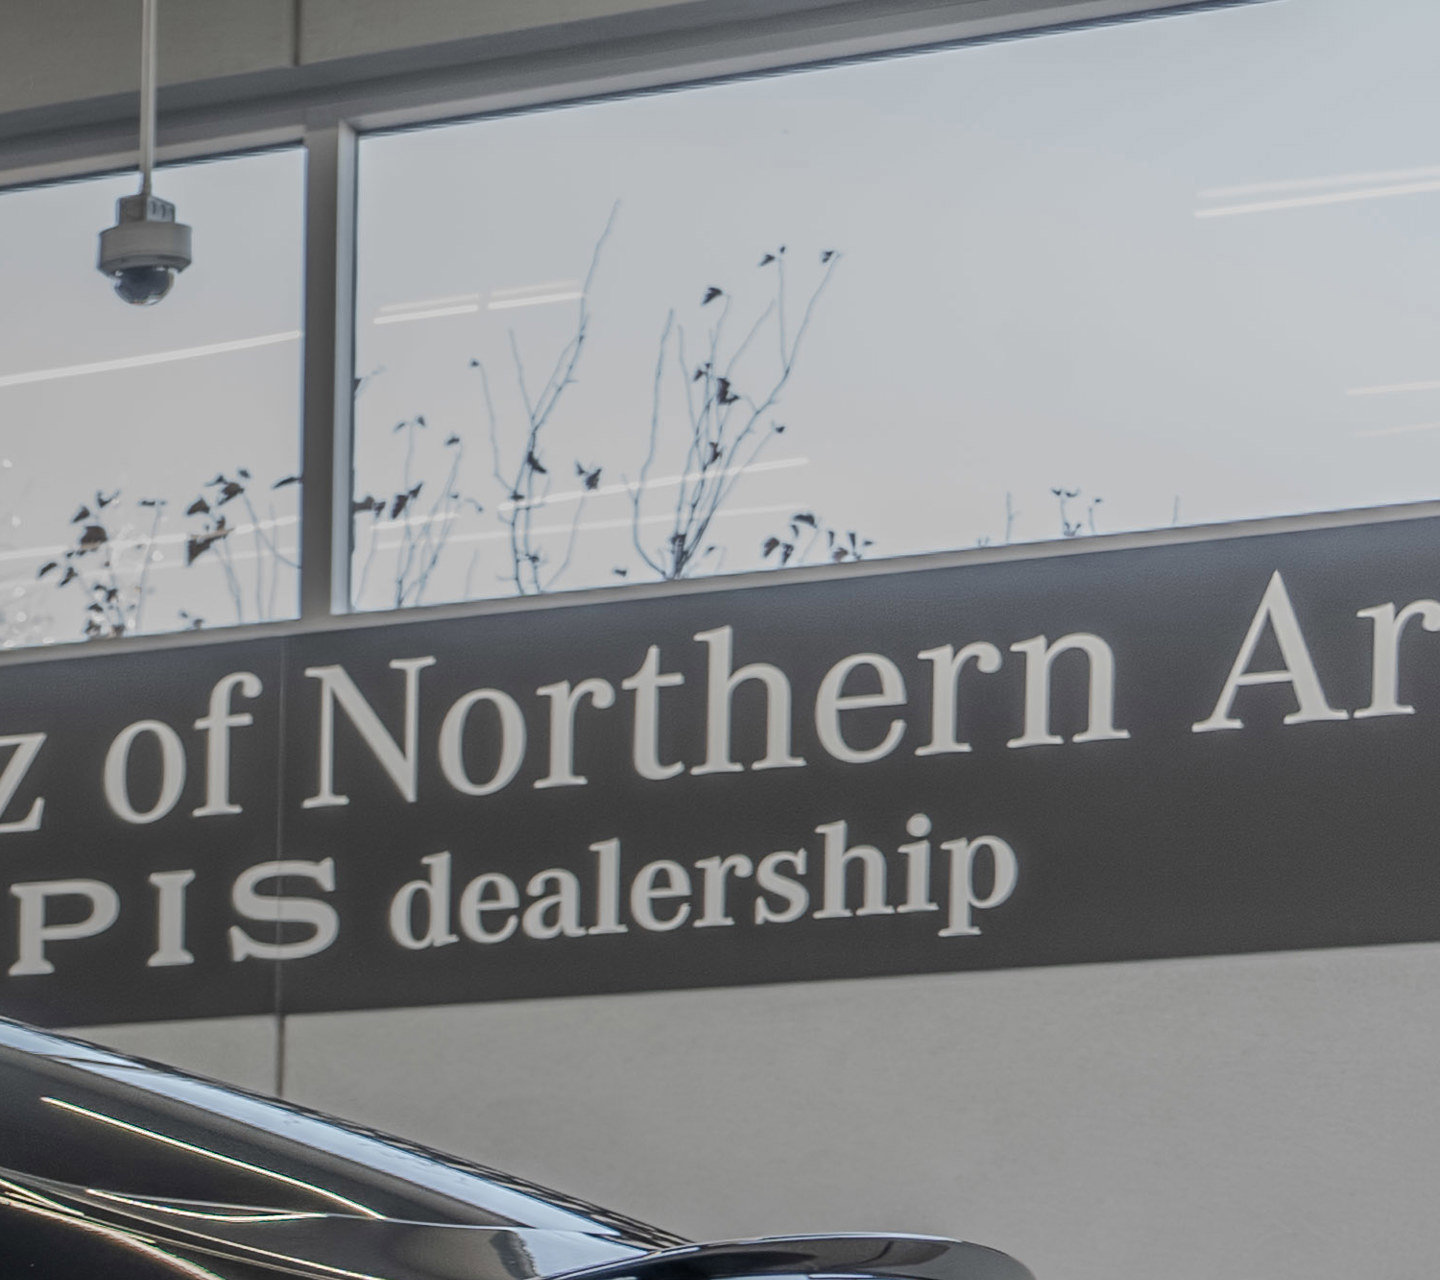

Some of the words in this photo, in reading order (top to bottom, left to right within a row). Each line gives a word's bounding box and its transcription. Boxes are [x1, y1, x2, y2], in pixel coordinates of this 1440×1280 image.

[101, 671, 263, 825] of
[301, 624, 1131, 810] Northern
[389, 812, 1021, 951] dealership
